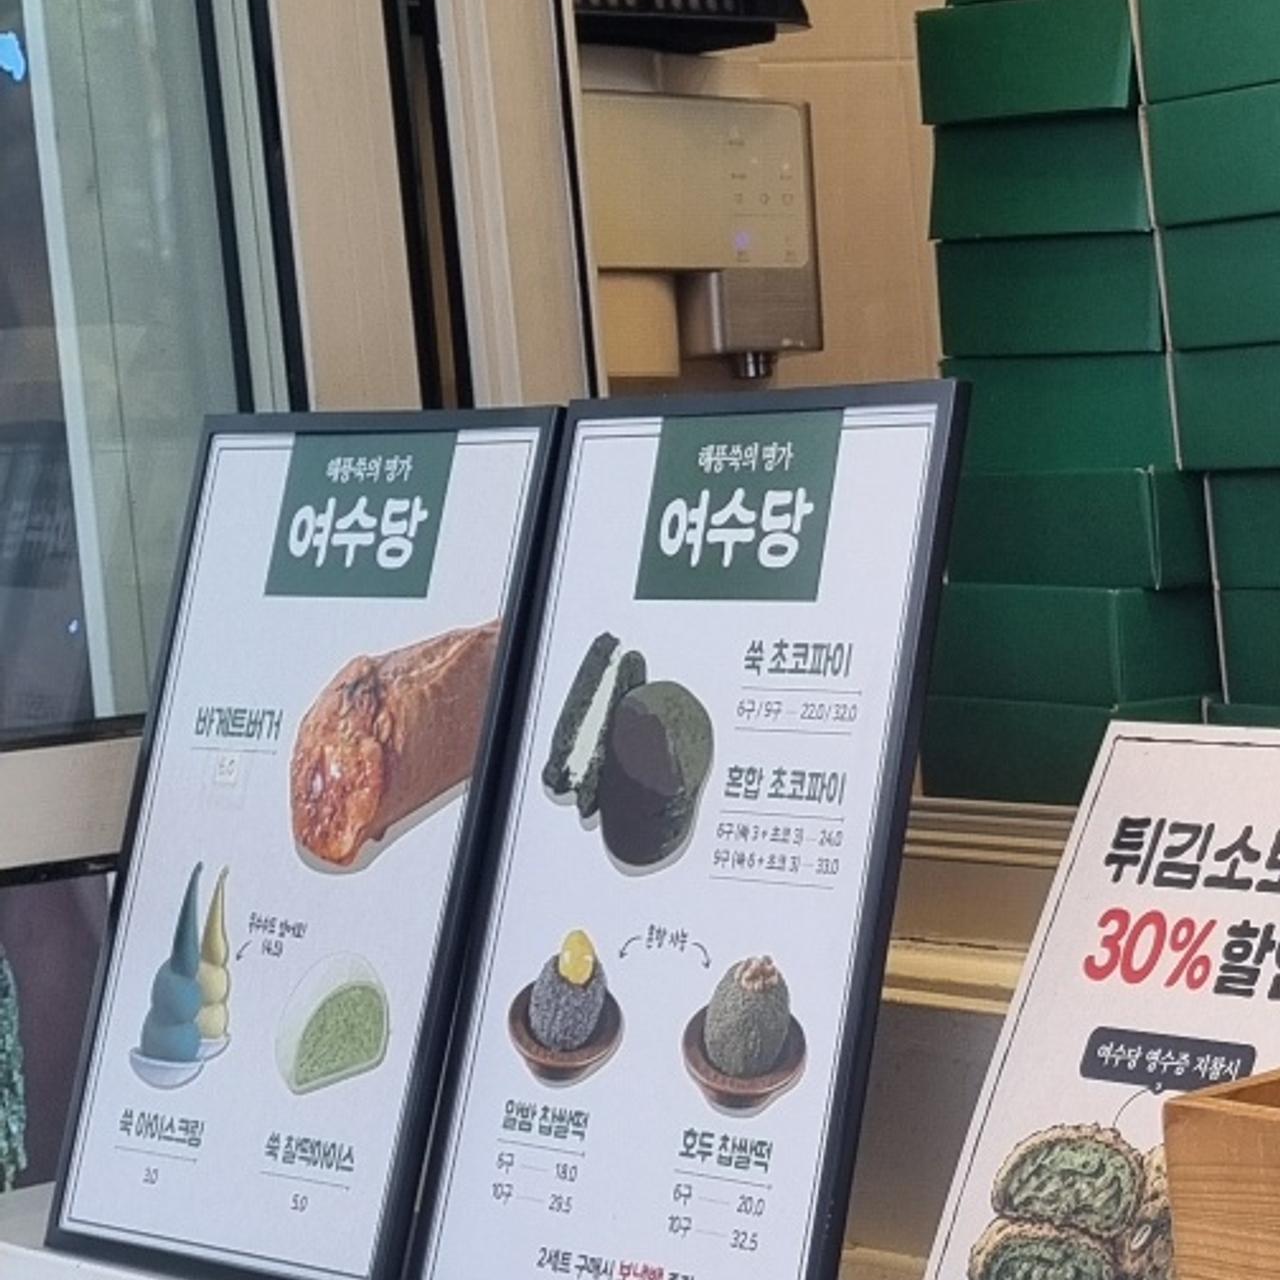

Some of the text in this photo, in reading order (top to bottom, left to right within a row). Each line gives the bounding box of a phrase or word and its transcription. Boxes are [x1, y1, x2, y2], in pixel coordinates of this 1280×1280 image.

[762, 442, 794, 472] 명가
[288, 495, 429, 569] 여수당
[659, 487, 814, 569] 여수당
[744, 638, 853, 678] 쑥 초코파이
[194, 706, 284, 741] 바게트버거
[724, 765, 847, 806] 혼합 초코파이
[1083, 907, 1218, 991] 30%
[1096, 1042, 1242, 1082] 여수당 영수증 지참시
[119, 1109, 204, 1147] 쑥 아이스크림
[503, 1099, 590, 1141] 알밤 찹쌀떡
[264, 1131, 280, 1161] 쑥
[678, 1127, 773, 1174] 호두 찹쌀떡
[736, 1193, 766, 1217] 20.0
[729, 1228, 759, 1252] 32.5
